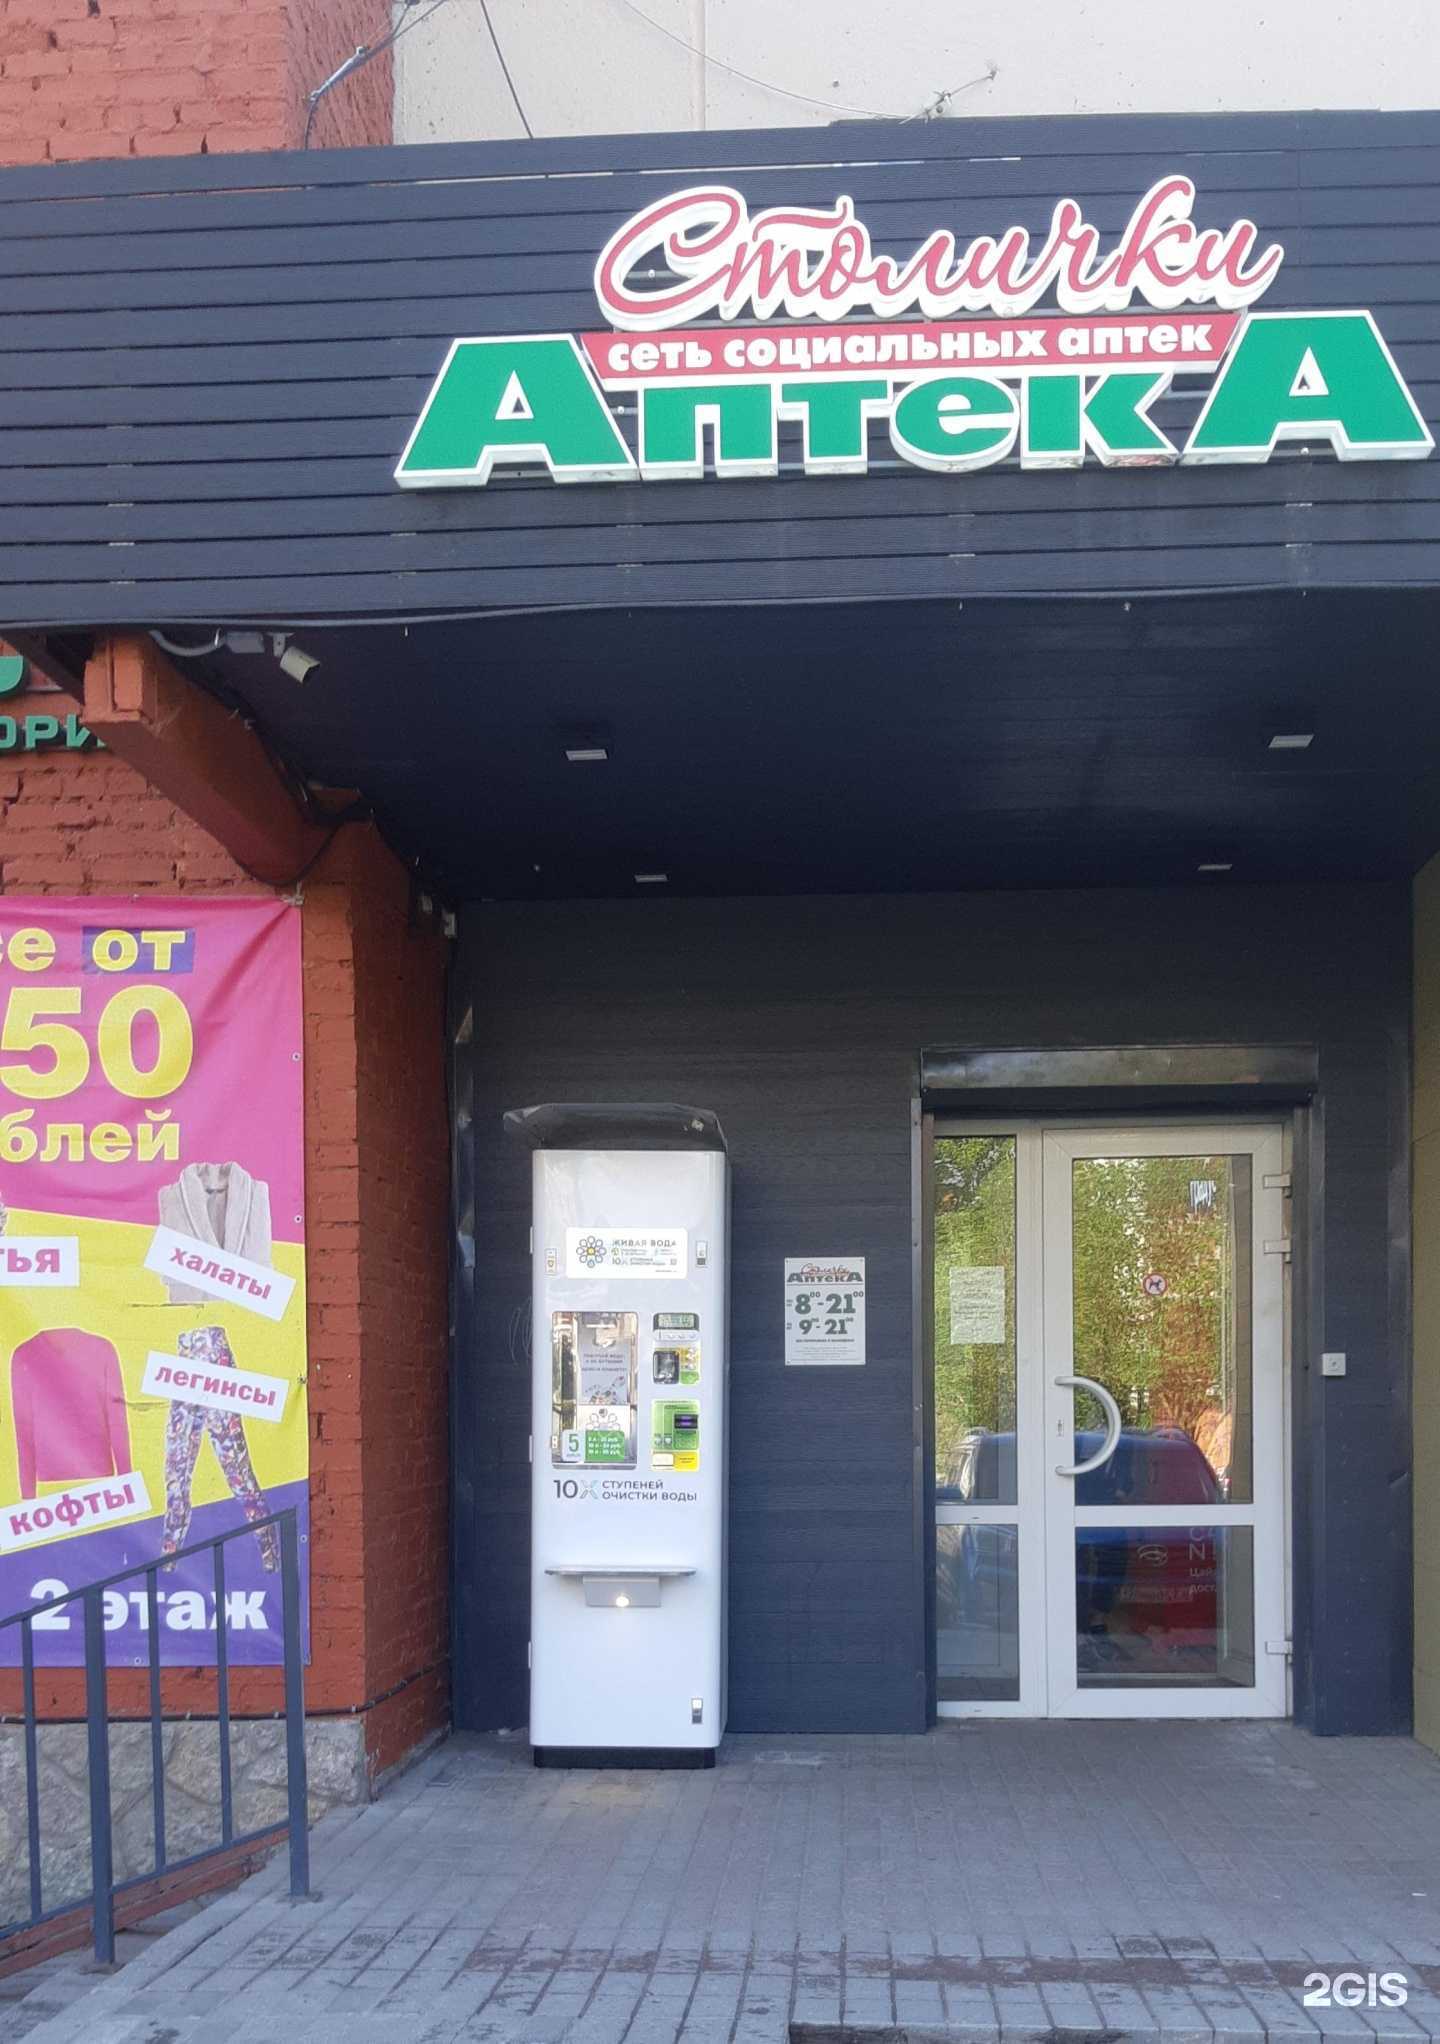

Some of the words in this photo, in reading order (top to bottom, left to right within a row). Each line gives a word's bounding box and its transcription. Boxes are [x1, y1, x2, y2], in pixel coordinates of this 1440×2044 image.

[595, 177, 1284, 330] Столички
[607, 338, 713, 373] сеть
[725, 326, 1048, 368] социальных
[1059, 323, 1214, 357] аптек
[0, 927, 56, 972] е
[0, 1109, 181, 1162] блей
[650, 1239, 677, 1247] ВОДА
[169, 1242, 272, 1301] халаты
[154, 1364, 277, 1407] легинсы
[568, 1433, 580, 1452] 5
[602, 1479, 664, 1490] СТУПЕНЕЙ
[602, 1491, 658, 1501] ОЧИСТКИ
[661, 1492, 697, 1502] ВОДЫ
[9, 1480, 137, 1537] кофты
[30, 1578, 71, 1630] 2
[102, 1590, 269, 1631] этаж
